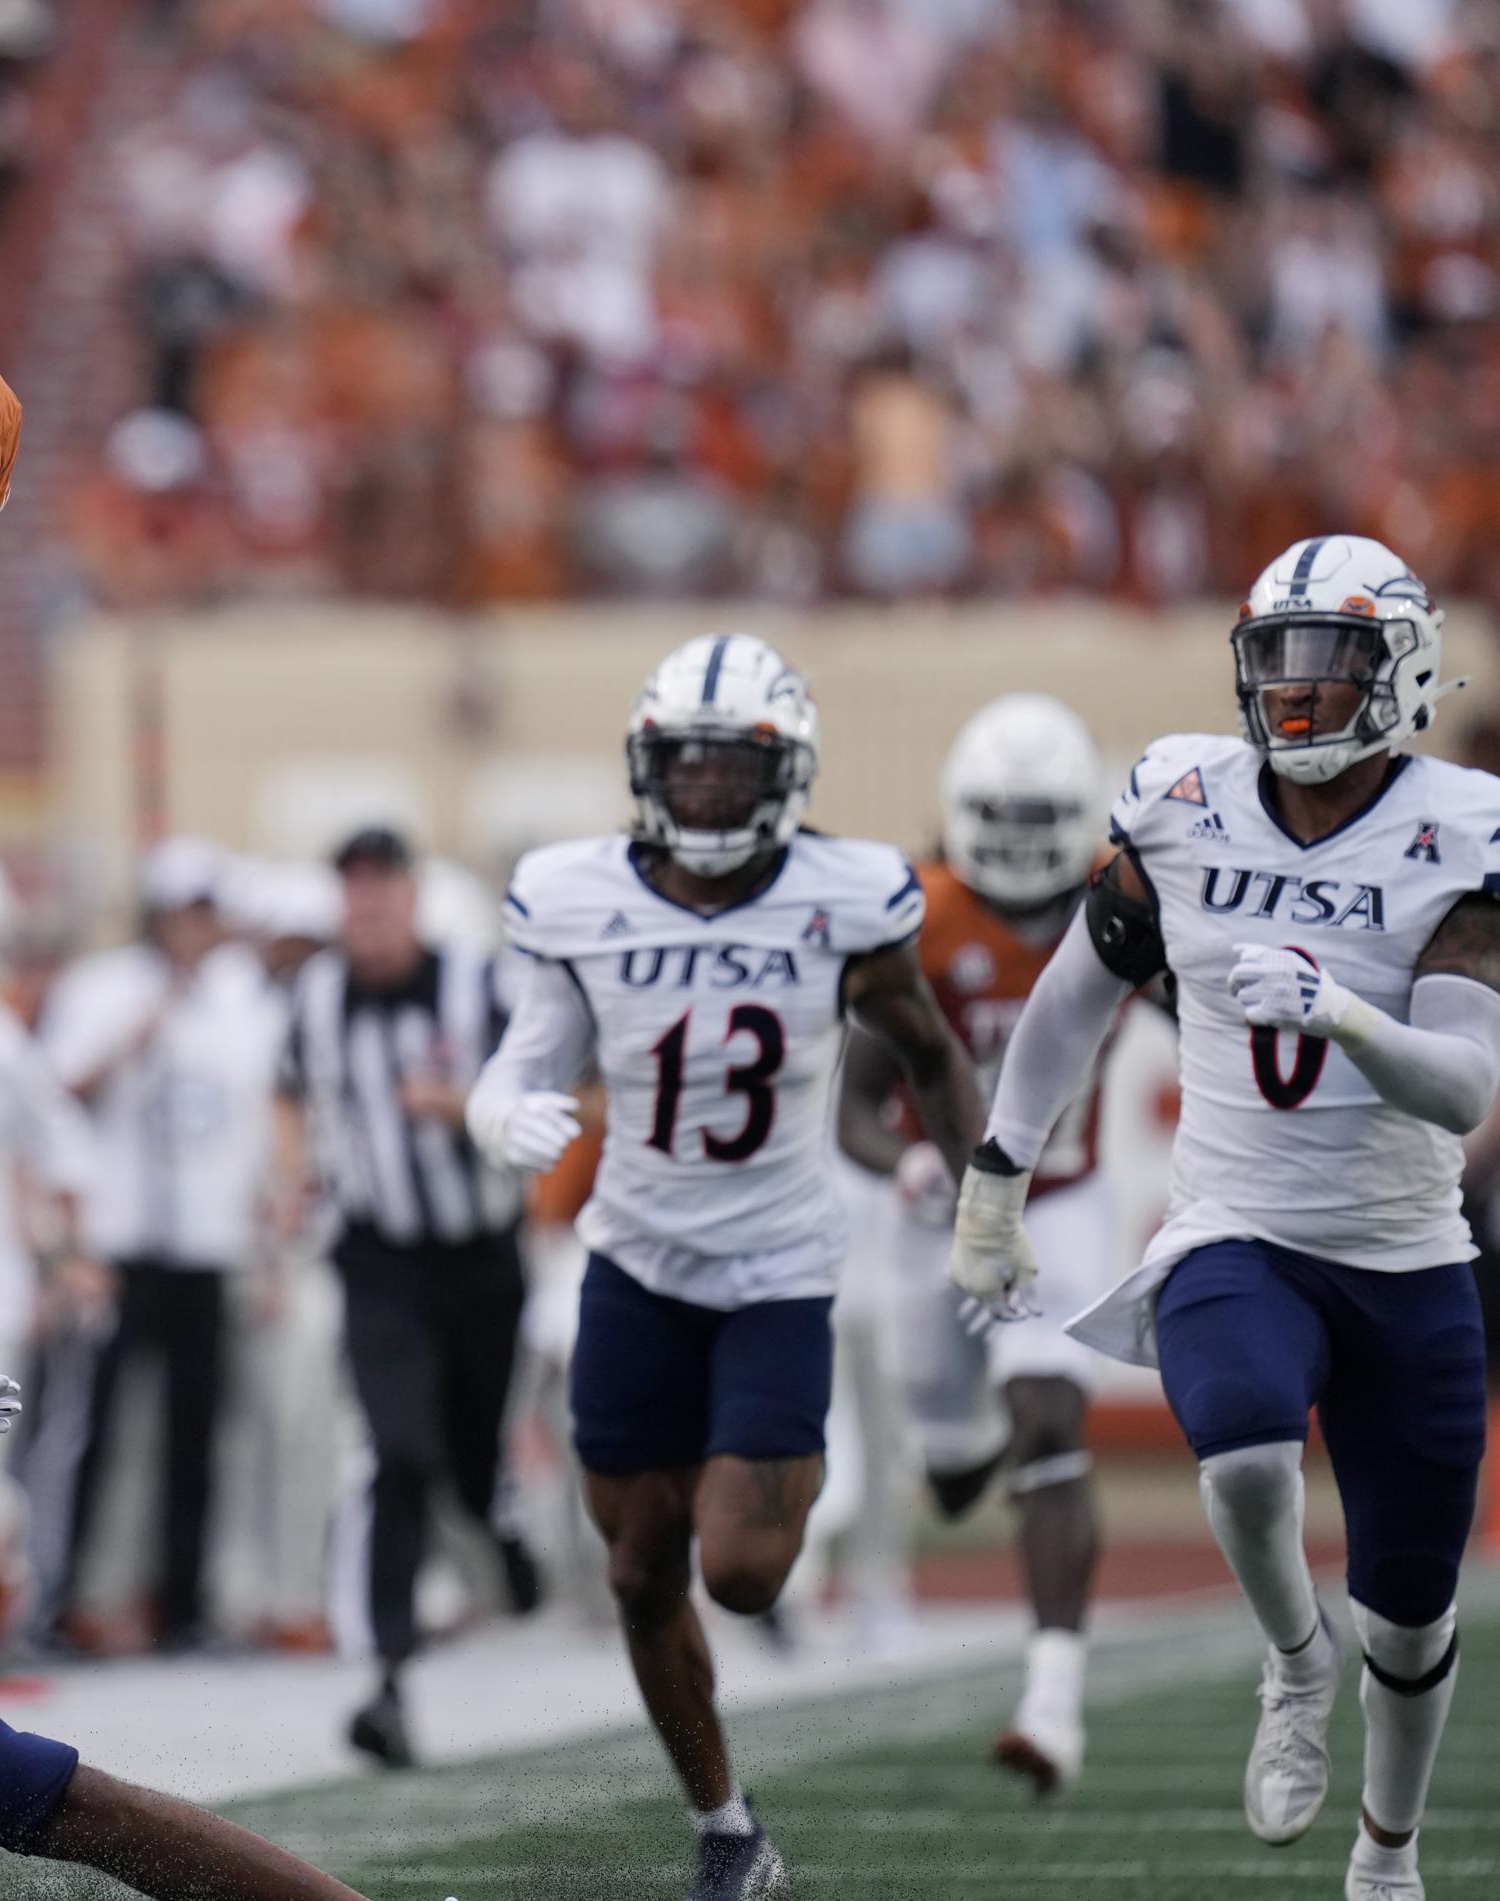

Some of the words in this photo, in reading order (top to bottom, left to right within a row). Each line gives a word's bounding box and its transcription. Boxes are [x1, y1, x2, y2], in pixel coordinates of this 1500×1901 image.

[1273, 599, 1313, 611] UTSA
[1200, 866, 1386, 931] UTSA
[619, 943, 804, 989] UTSA
[644, 1003, 787, 1163] 13
